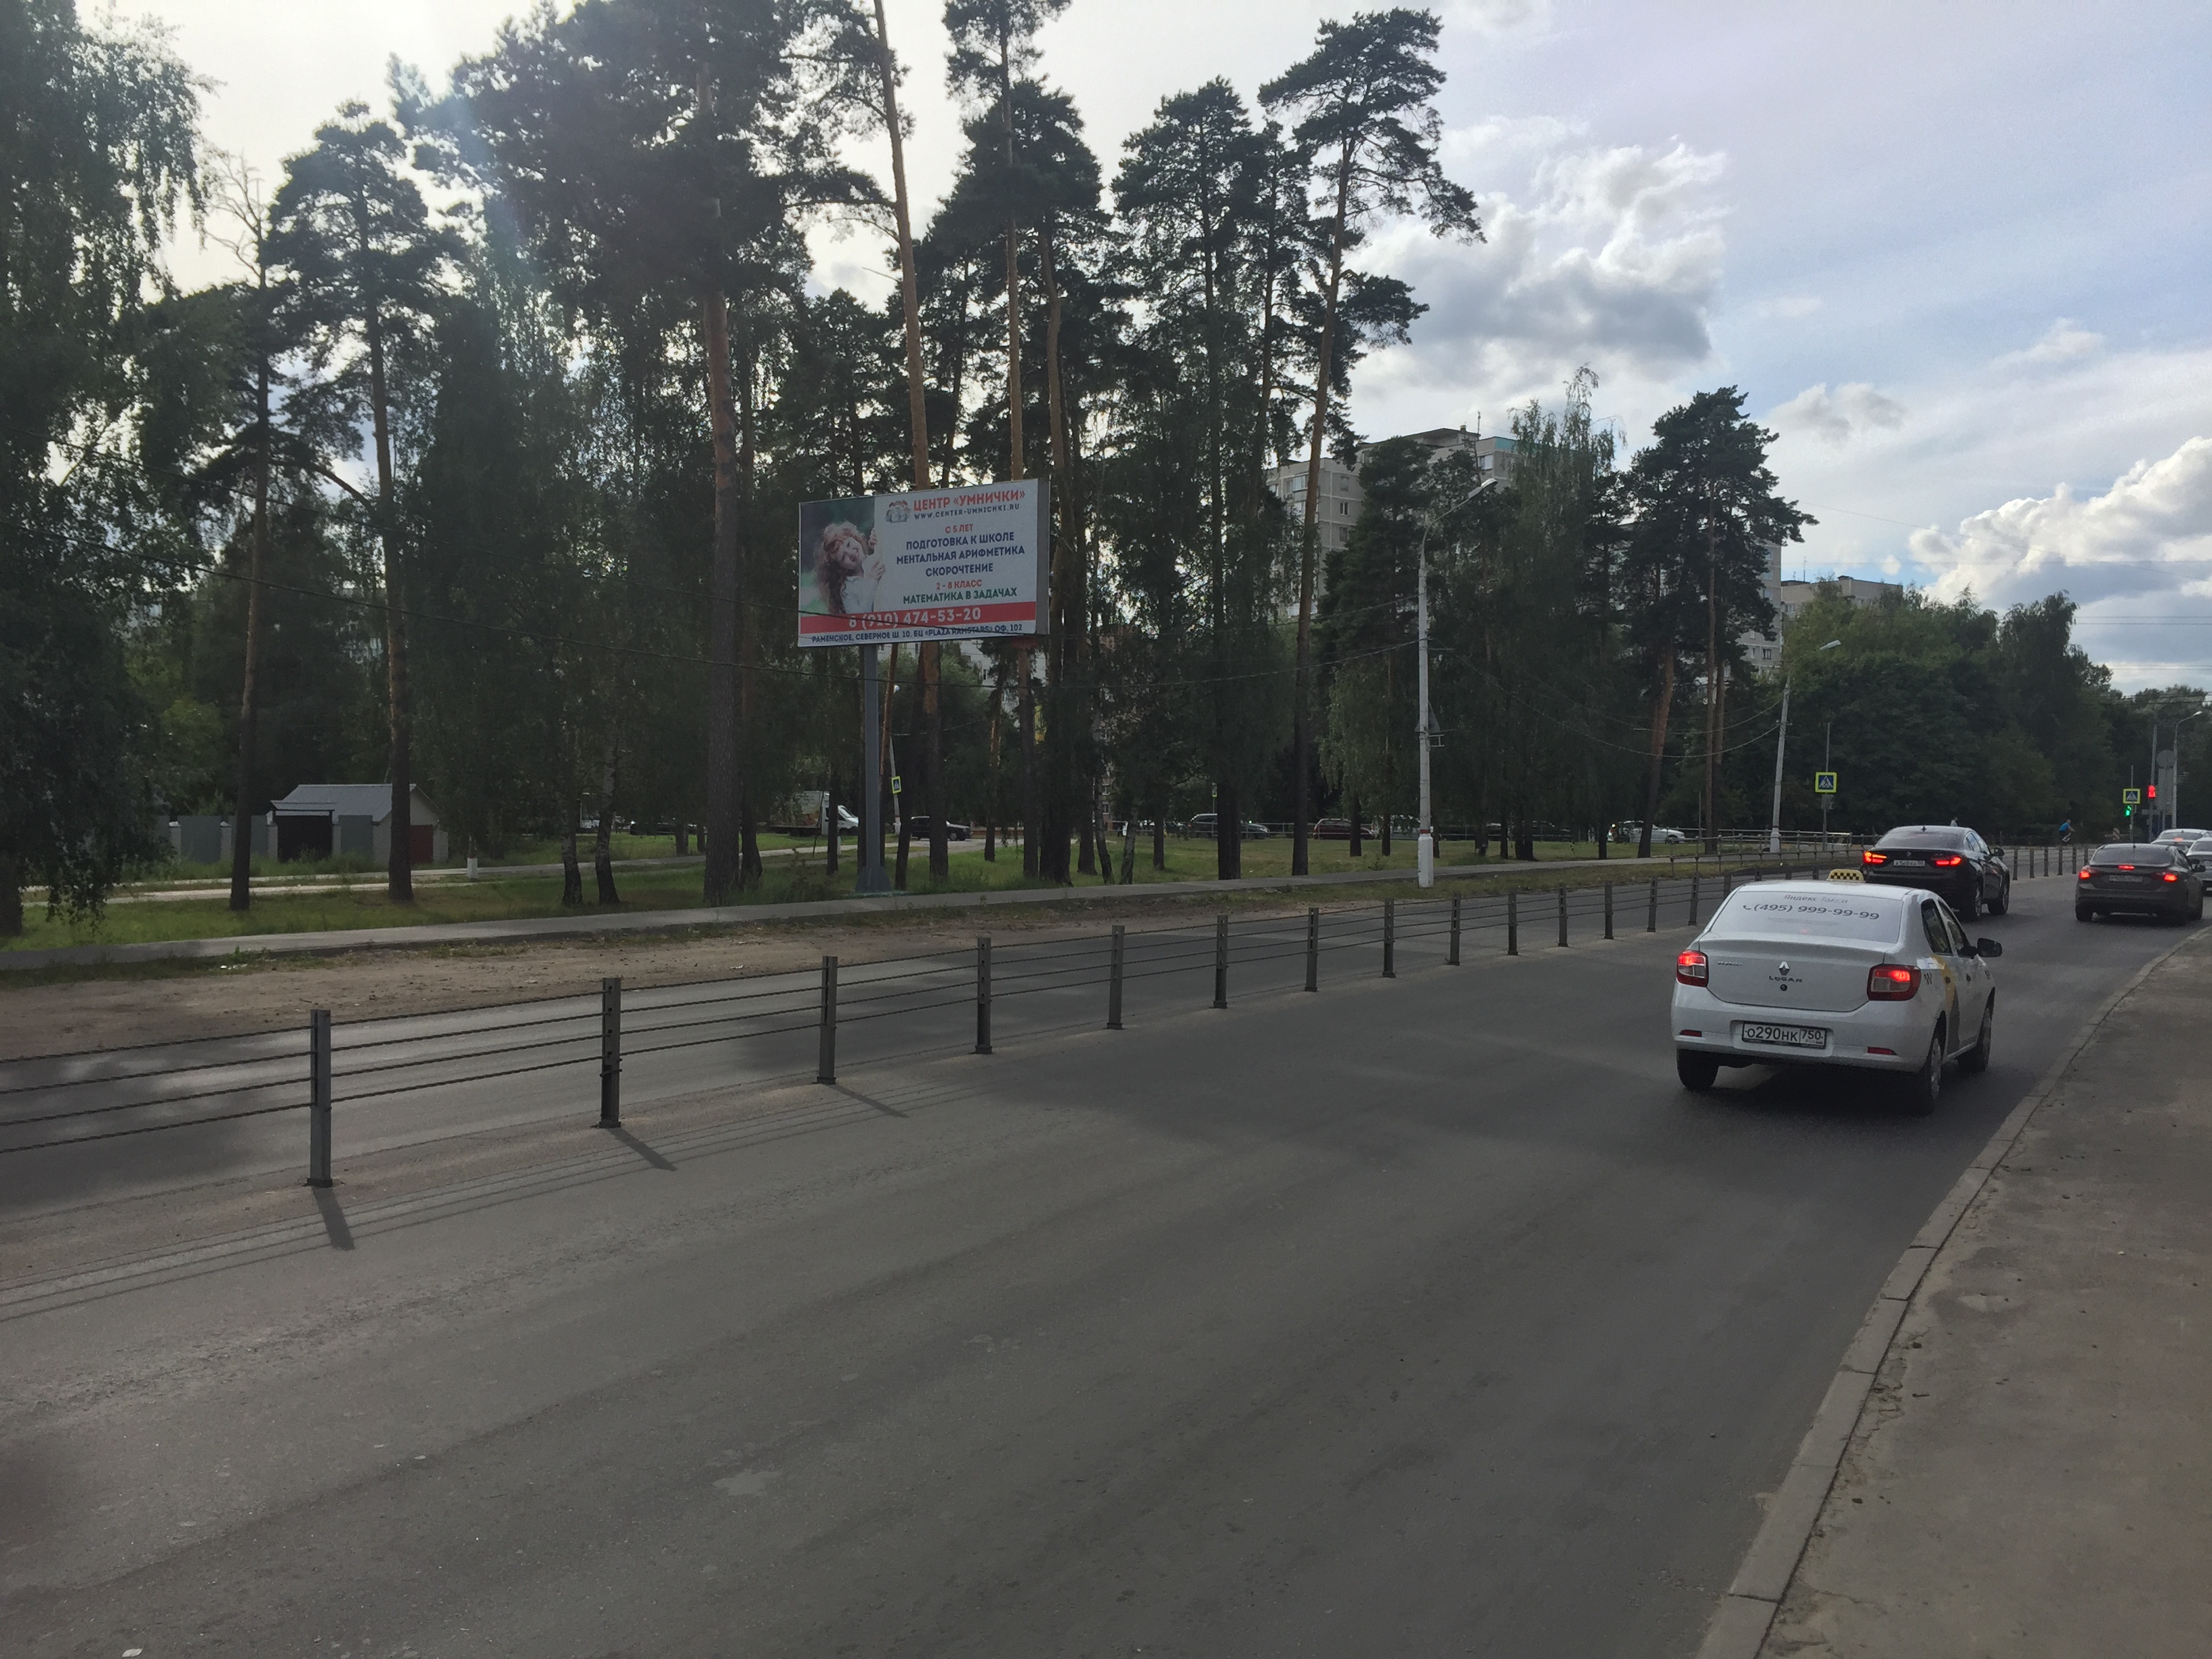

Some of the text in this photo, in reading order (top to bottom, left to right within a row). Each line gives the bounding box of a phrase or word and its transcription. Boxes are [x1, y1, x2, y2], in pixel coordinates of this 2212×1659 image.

[914, 489, 1025, 512] ЦЕНТР «УМНИЧКИ»
[914, 504, 1020, 520] WWW.CENTER-UMNICHKI.RU
[953, 525, 958, 533] 5
[958, 524, 974, 533] ЛЕТ
[906, 531, 1015, 550] ПОДГОТОВКА К ШКОЛЕ
[897, 546, 1025, 565] МЕНТАЛЬНАЯ АРИФМЕТИКА
[925, 562, 994, 577] СКОРОЧТЕНИЕ
[936, 582, 941, 590] 2
[954, 579, 982, 589] КЛАСС
[903, 587, 1017, 605] МАТЕМАТИКА В ЗАДАЧАХ
[848, 607, 981, 630] 8 (910) 474-53-20
[855, 631, 890, 640] СЕВЕРНОЕ
[925, 628, 950, 636] «PLAZA
[994, 624, 1008, 632] ОФ.
[1010, 623, 1023, 632] 102
[1754, 903, 1880, 920] (495) 999-99-99
[1746, 1027, 1822, 1042] О290НК 750
